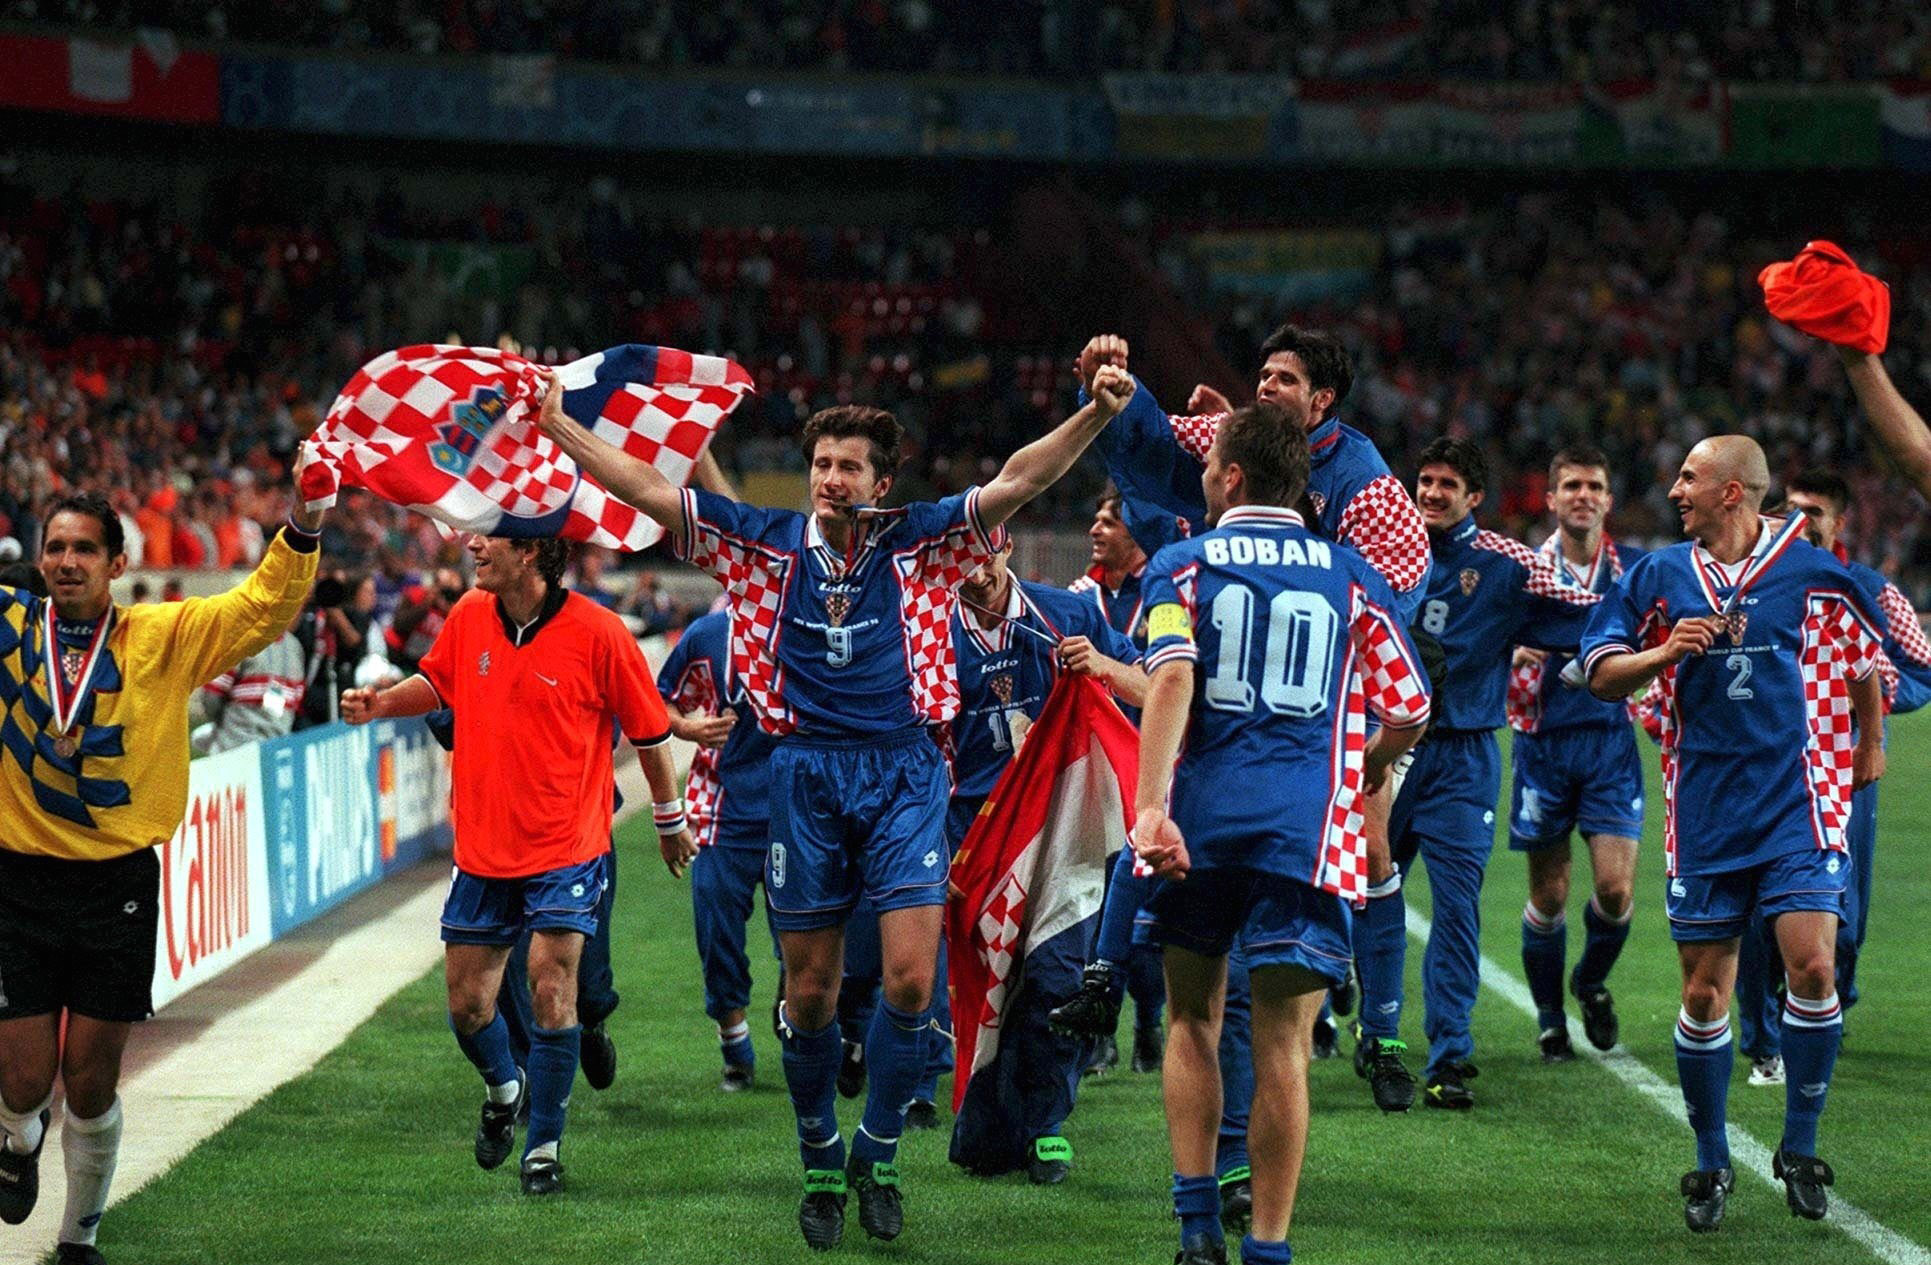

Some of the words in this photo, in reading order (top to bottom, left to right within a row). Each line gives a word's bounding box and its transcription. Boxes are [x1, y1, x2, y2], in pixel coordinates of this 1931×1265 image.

[1203, 536, 1332, 570] BOBAN
[1423, 599, 1449, 634] 8
[825, 626, 852, 668] 9
[981, 659, 1019, 675] lotto
[1205, 583, 1338, 718] 10
[1726, 654, 1754, 700] 2
[988, 708, 1028, 752] 1
[162, 783, 249, 981] Canon
[771, 842, 787, 889] 9
[1039, 1144, 1067, 1153] lotto
[805, 1174, 843, 1185] lotto
